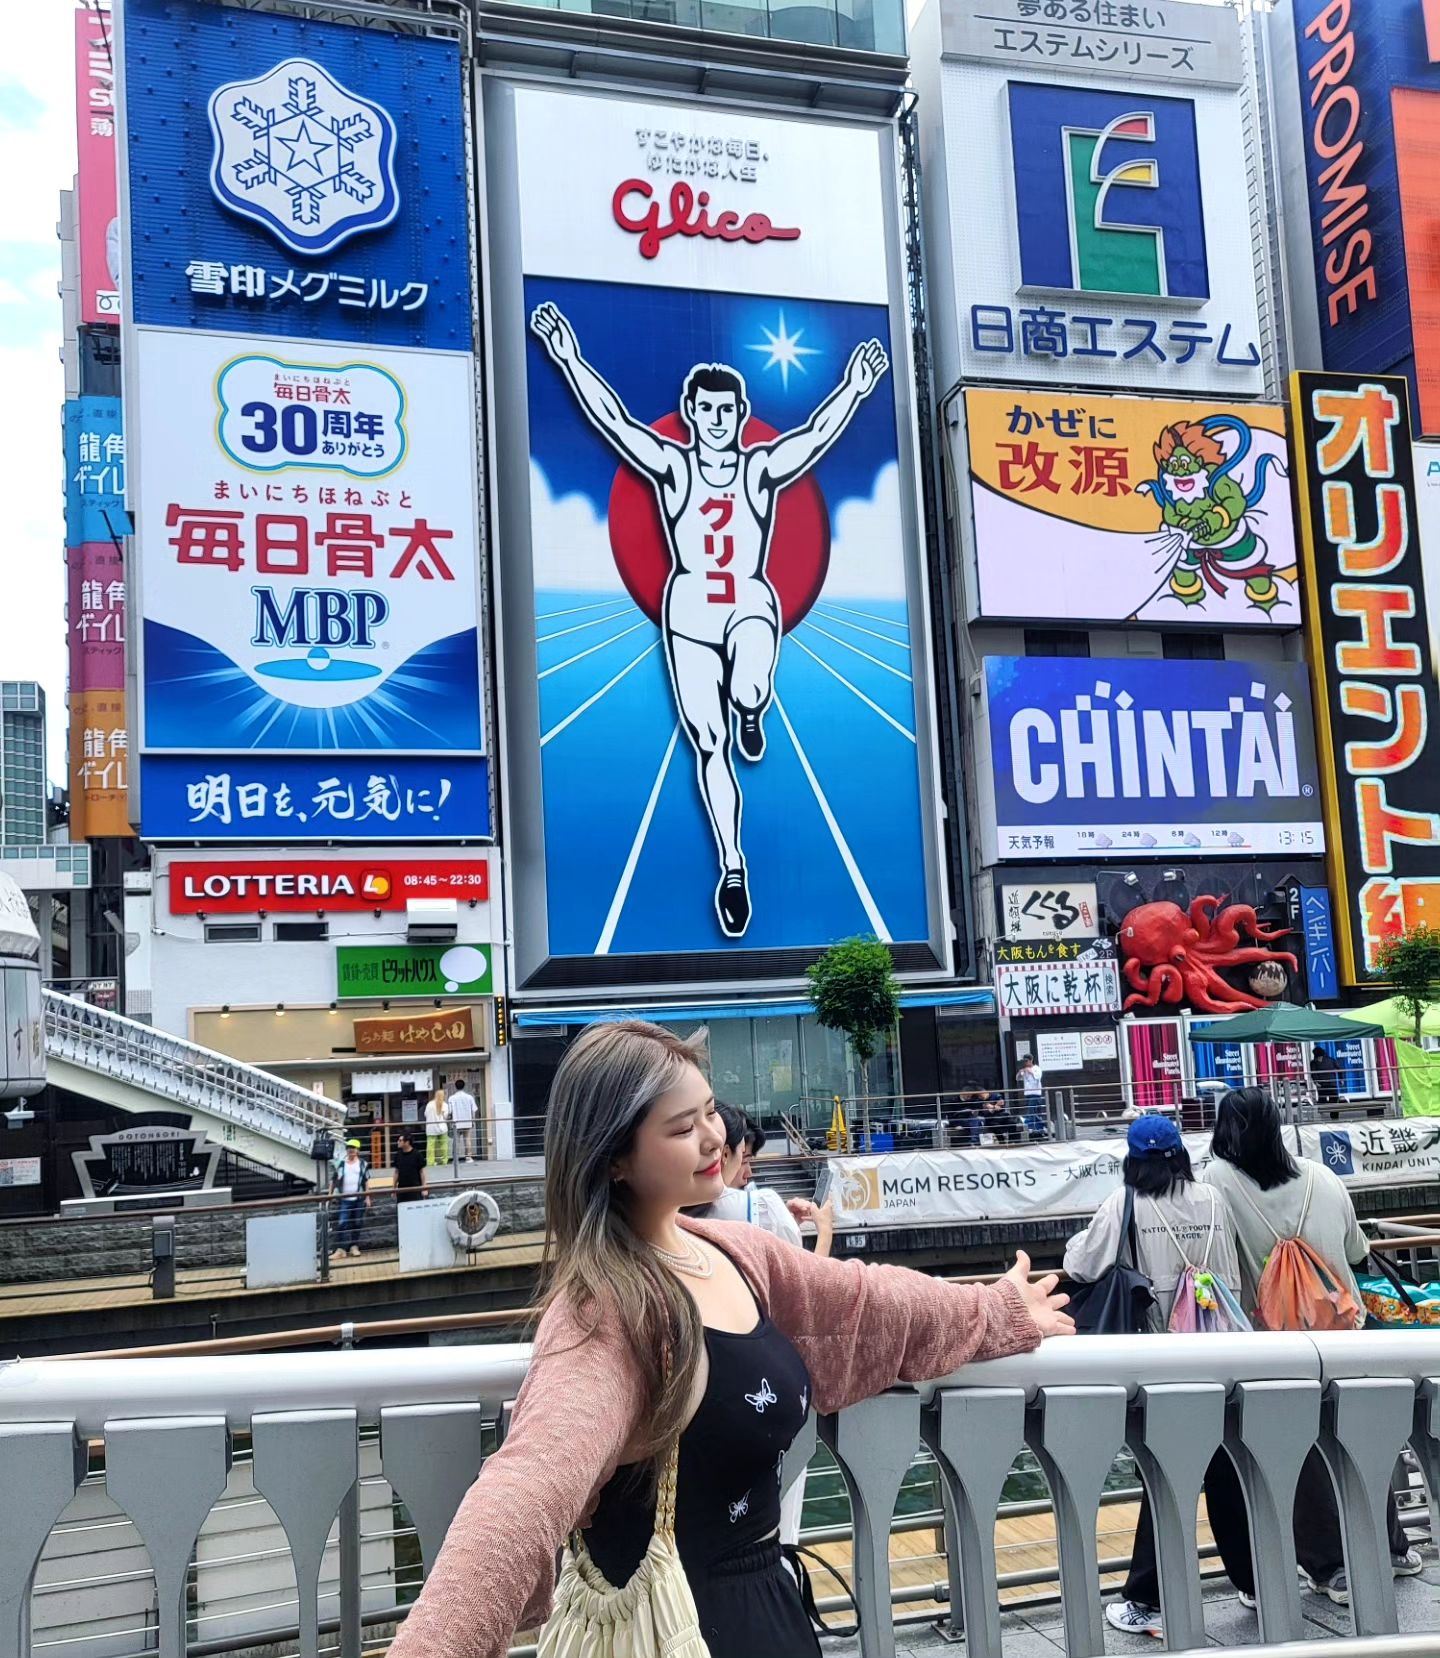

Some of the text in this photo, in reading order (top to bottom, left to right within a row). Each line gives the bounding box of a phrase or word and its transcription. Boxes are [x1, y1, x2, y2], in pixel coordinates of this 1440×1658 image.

[1015, 0, 1166, 30] 夢ある住まい
[993, 27, 1195, 72] エステムシリーズ
[647, 152, 757, 183] ゆたかな人生
[1304, 0, 1378, 328] PROMISE
[612, 178, 801, 259] Glico
[185, 260, 429, 311] 雪印メグミルク
[970, 303, 1262, 368] 日商エステム
[273, 382, 351, 405] 毎日骨太
[274, 373, 351, 387] まいにちほねぶと
[240, 401, 385, 456] 30周年
[1006, 404, 1117, 439] かぜに
[322, 440, 385, 458] ありがとう
[995, 441, 1136, 498] 改源
[213, 479, 413, 509] まいにちほねぶと
[165, 502, 456, 581] 毎日骨太
[698, 493, 736, 604] グリコ
[250, 585, 390, 649] MBP
[186, 773, 452, 823] 明日を、元気に!
[1008, 834, 1055, 850] 天気予報
[1278, 830, 1315, 845] 13:15
[184, 874, 355, 897] LOTTERIA
[1021, 890, 1080, 930] くくる
[997, 943, 1081, 961] 大阪もんを食す
[1099, 950, 1114, 960] 2F
[381, 957, 438, 983] ピタットハウス
[1004, 969, 1102, 1006] 大阪に乾杯
[118, 1131, 180, 1140] DOTONBORI
[1362, 1160, 1403, 1172] KINDAI
[882, 1177, 931, 1196] MGM
[938, 1169, 1037, 1192] RESORTS
[883, 1198, 916, 1209] JAPAN
[1141, 1225, 1180, 1234] NATIOAL
[1172, 1233, 1202, 1242] EAGUE
